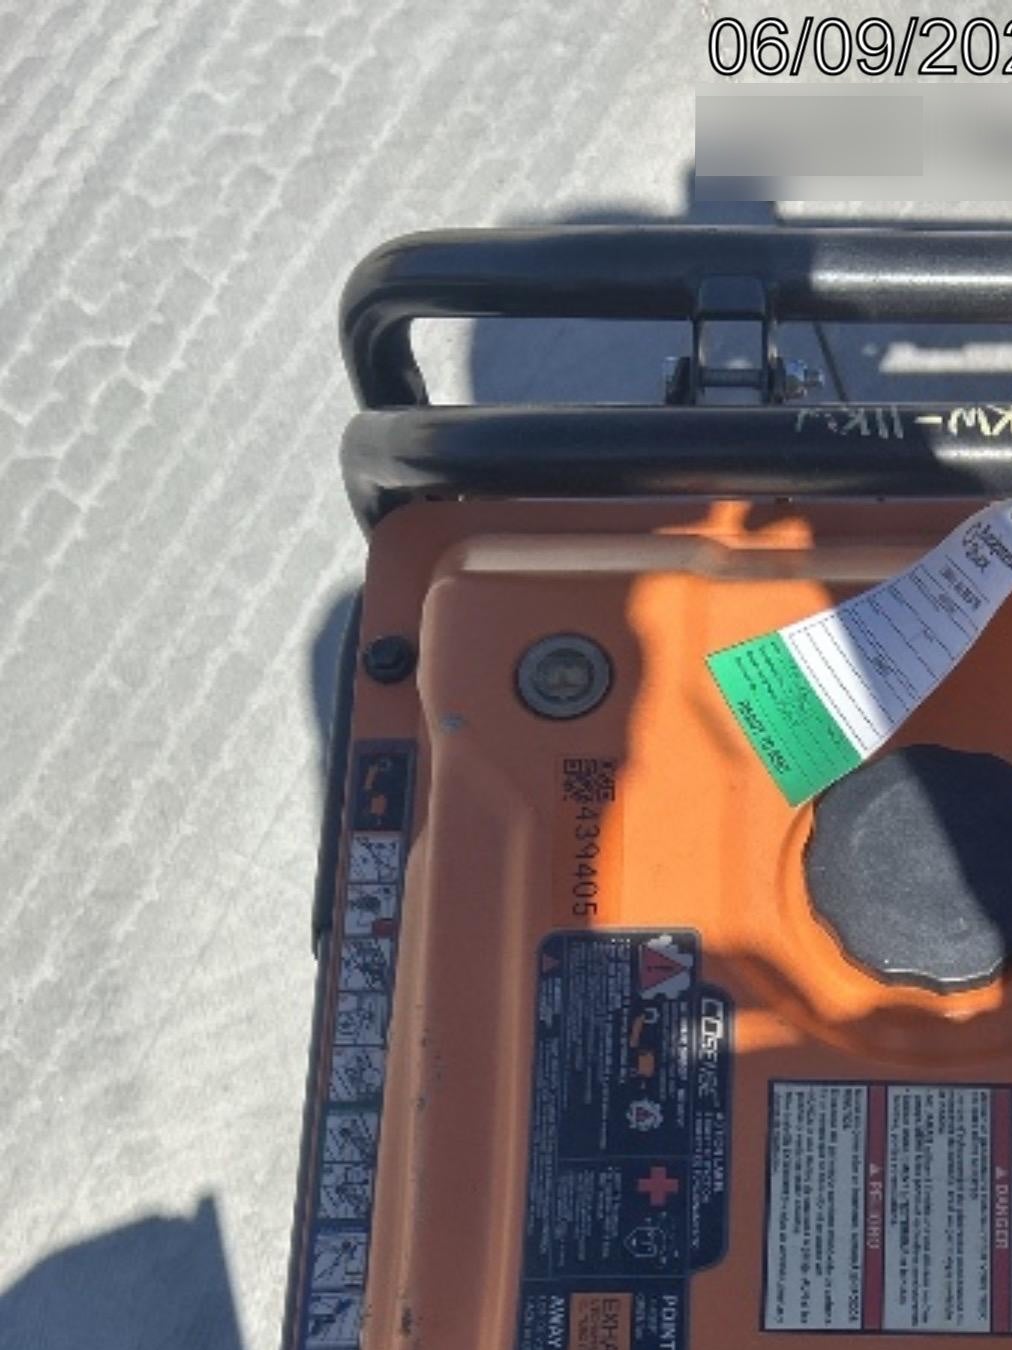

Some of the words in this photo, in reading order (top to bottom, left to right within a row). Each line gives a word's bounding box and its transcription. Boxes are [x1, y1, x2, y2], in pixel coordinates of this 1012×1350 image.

[572, 806, 601, 917] 439405
[995, 1183, 1009, 1248] DANGER
[548, 1295, 566, 1348] AWAY
